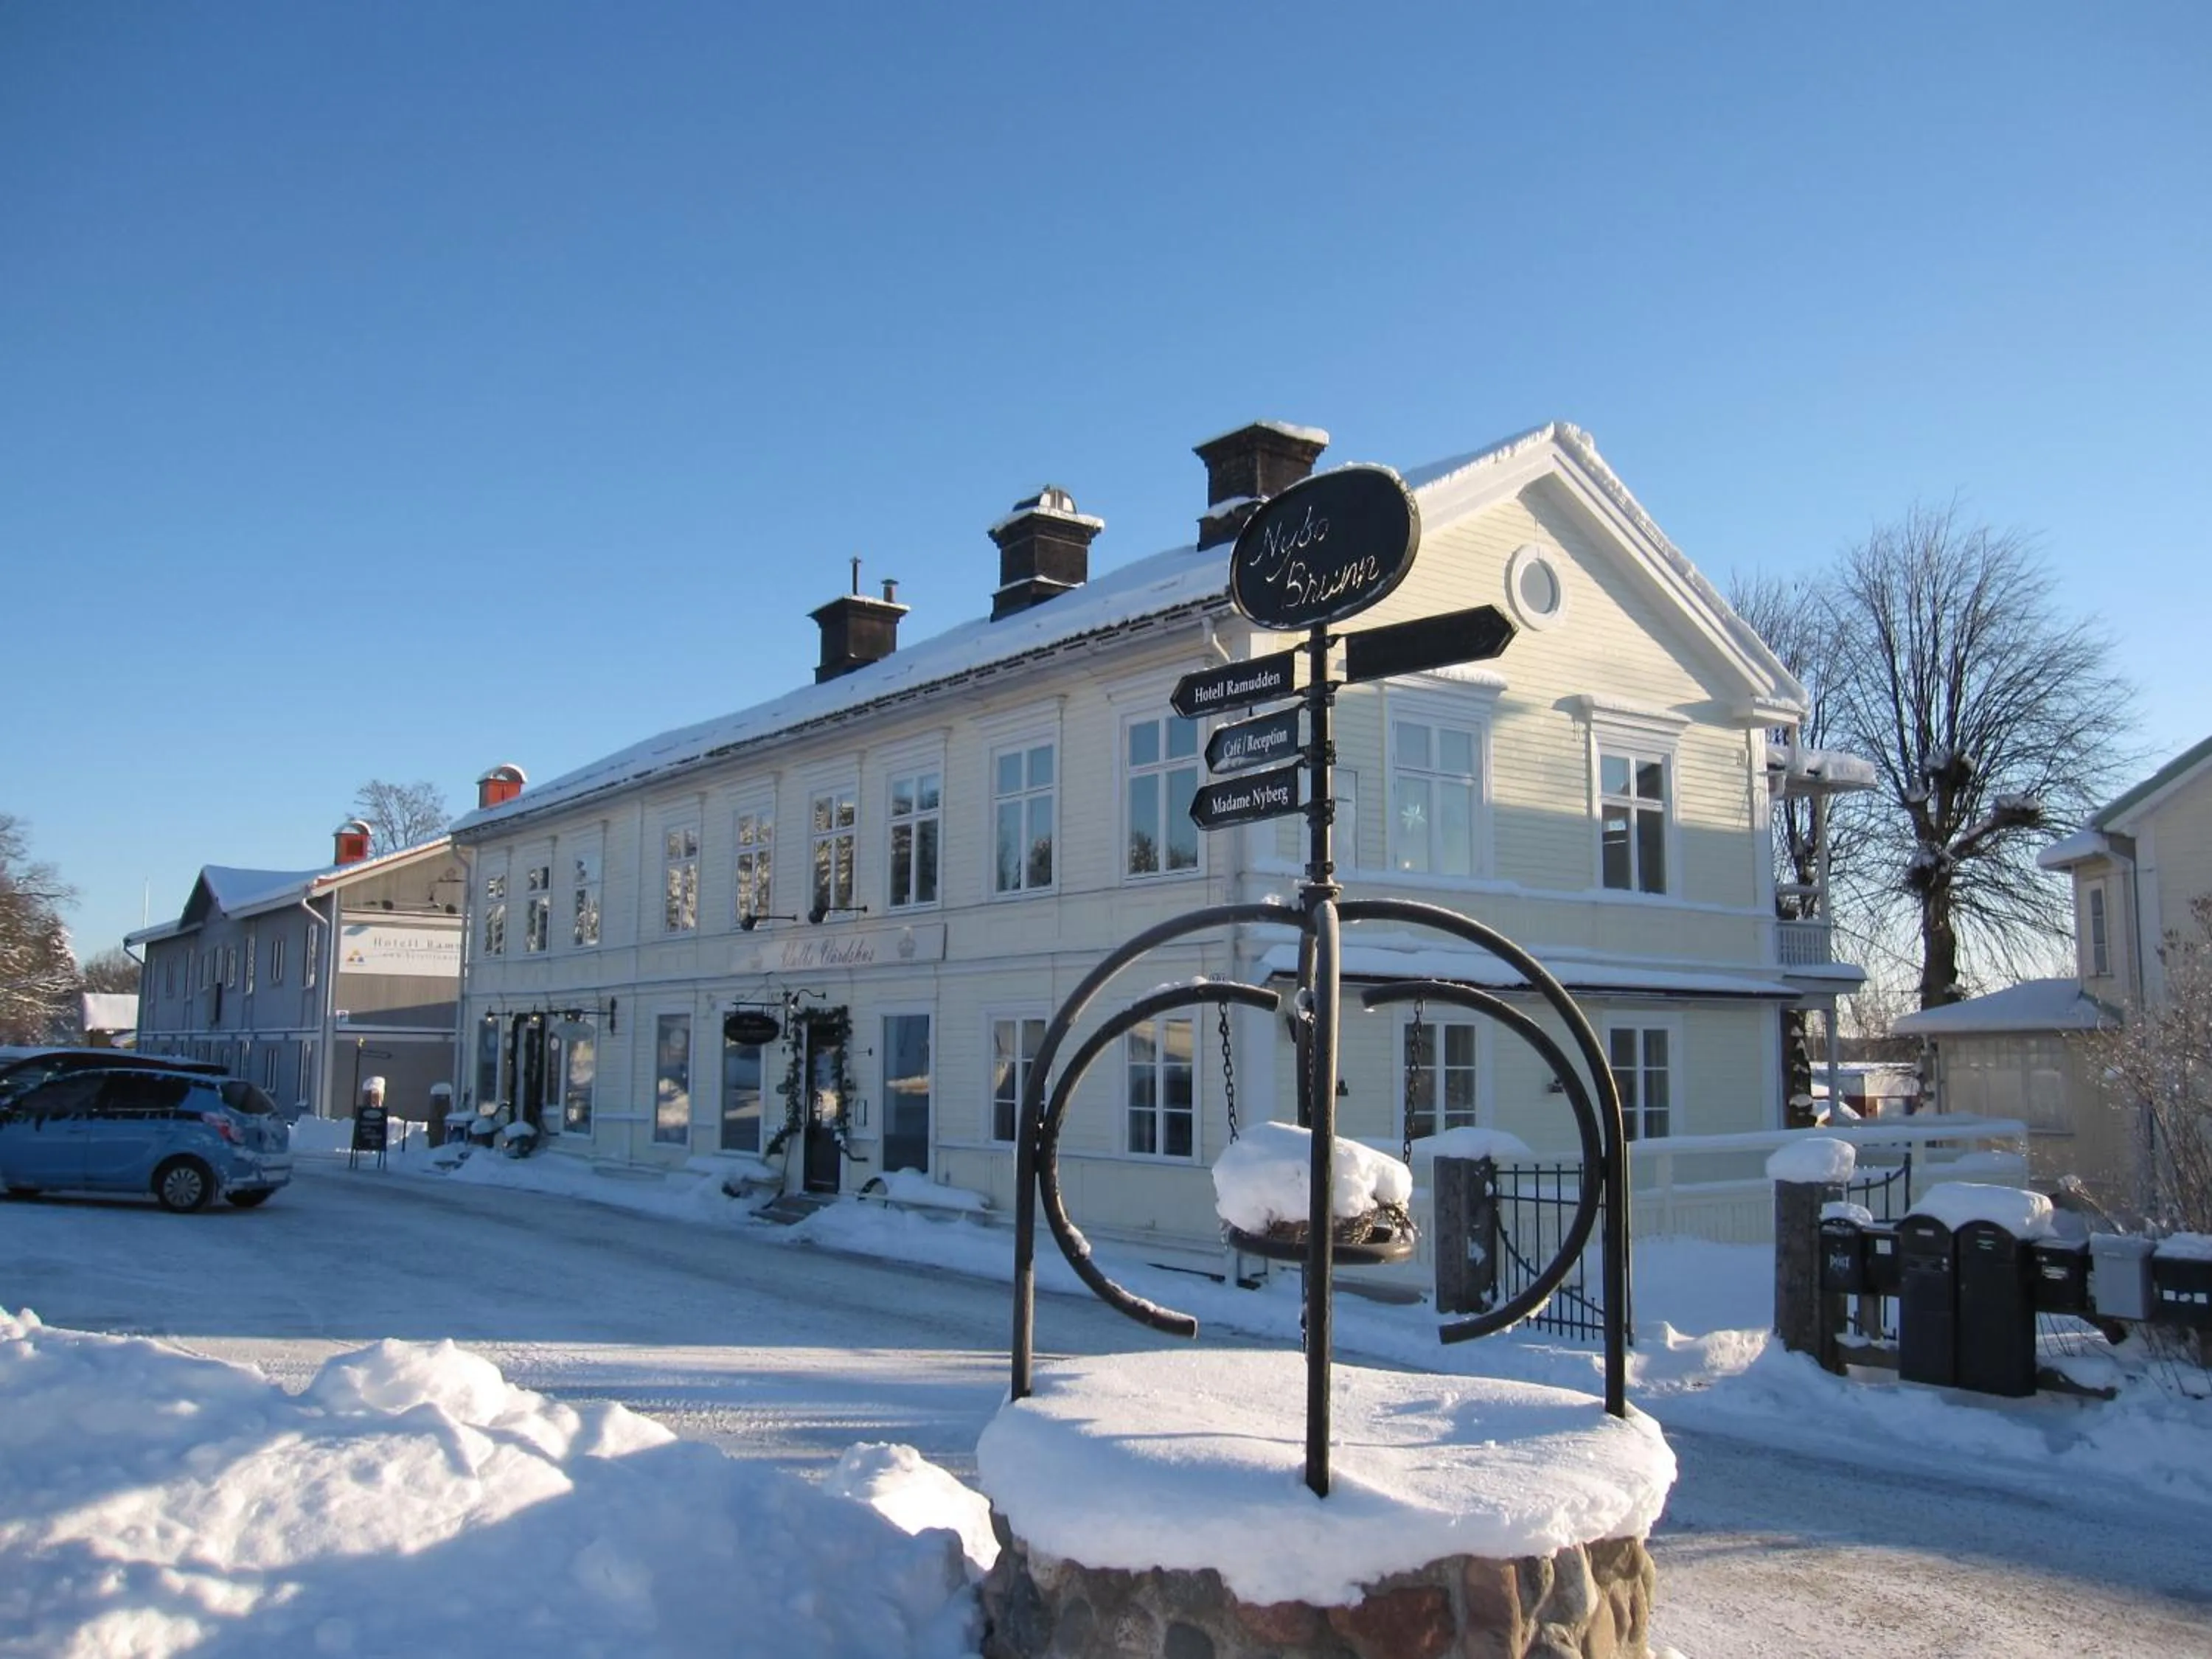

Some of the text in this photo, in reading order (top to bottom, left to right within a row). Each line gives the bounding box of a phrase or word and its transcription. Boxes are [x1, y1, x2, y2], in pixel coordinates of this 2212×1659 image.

[1194, 670, 1281, 703] Hotell Ramudden
[1211, 785, 1288, 815] Madame Nyberg
